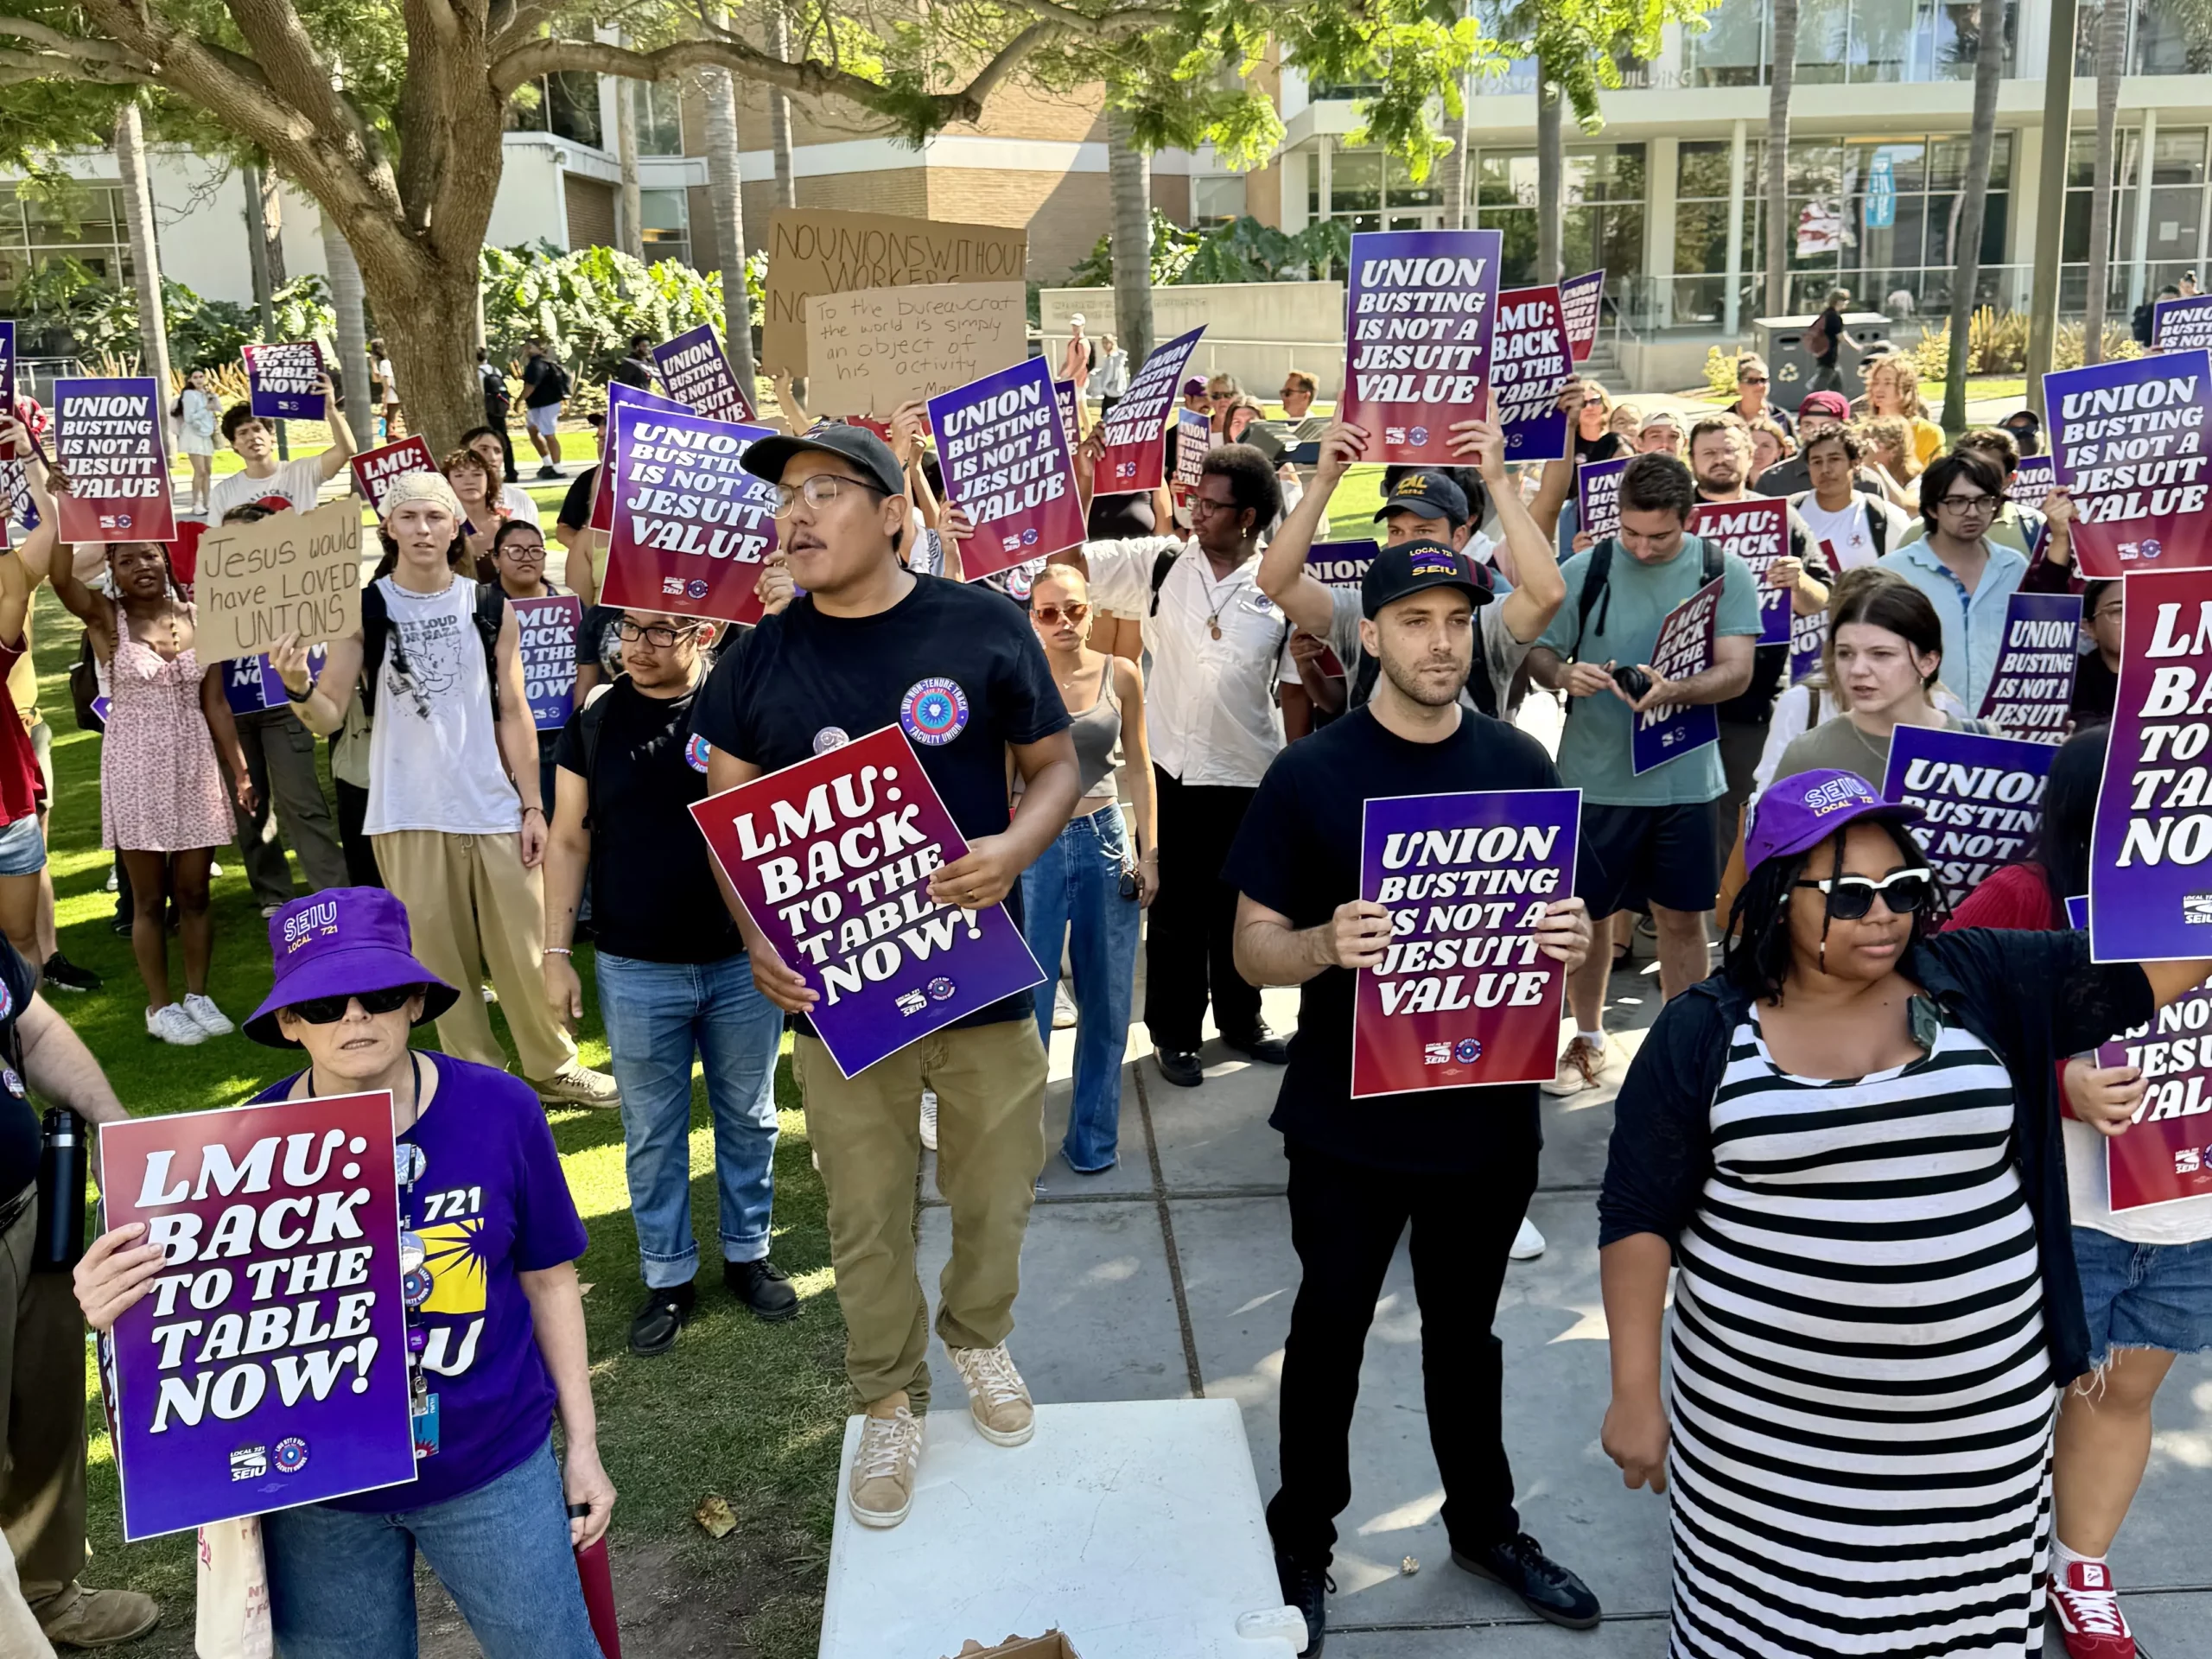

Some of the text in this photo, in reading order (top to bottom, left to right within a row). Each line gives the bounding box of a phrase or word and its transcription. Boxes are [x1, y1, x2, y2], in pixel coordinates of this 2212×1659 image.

[925, 236, 1027, 276] WITHOUT
[1361, 258, 1486, 288] UNION
[817, 296, 1017, 321] To the bureaucrat
[1357, 292, 1486, 313] BUSTING
[820, 318, 1001, 341] the world is simply
[1354, 319, 1479, 340] IS NOT A
[2160, 337, 2178, 348] IS
[252, 350, 315, 360] BACK
[662, 340, 714, 377] UNION
[827, 334, 977, 360] an object of
[1140, 340, 1195, 375] UNION
[1353, 346, 1483, 370] JESUIT
[255, 359, 316, 367] TO THE
[258, 367, 318, 378] TABLE
[669, 358, 722, 392] BUSTING
[836, 355, 976, 380] his activity
[1491, 356, 1564, 384] TO THE
[688, 379, 716, 401] NOT
[718, 372, 728, 388] A
[1130, 381, 1163, 402] NOT
[1158, 378, 1173, 395] A
[1356, 375, 1480, 404] VALUE
[2062, 375, 2197, 420] UNION
[63, 397, 149, 417] UNION
[944, 379, 1041, 437] UNION
[1107, 397, 1169, 423] JESUIT
[60, 421, 152, 435] BUSTING
[948, 406, 1051, 460] BUSTING
[1105, 418, 1162, 447] VALUE
[2062, 406, 2203, 444] BUSTING
[61, 439, 150, 454] IS NOT A
[952, 429, 1052, 481] IS NOT A
[2063, 431, 2200, 468] IS NOT A
[63, 458, 157, 475] JESUIT
[363, 447, 422, 480] LMU:
[957, 448, 1060, 502] JESUIT
[2067, 456, 2209, 495] JESUIT
[70, 478, 161, 499] VALUE
[628, 462, 767, 501] IS NOT A
[626, 486, 769, 530] JESUIT
[962, 472, 1065, 527] VALUE
[1587, 505, 1607, 520] IS
[2074, 484, 2209, 525] VALUE
[632, 515, 768, 563] VALUE
[1697, 511, 1780, 537] LMU:
[205, 516, 357, 578] Jesus would
[1409, 547, 1440, 556] LOCAL
[1412, 565, 1457, 576] SEIU
[210, 563, 358, 612] have LOVED
[235, 594, 344, 648] UNIONS
[422, 614, 457, 628] LOUD
[516, 606, 572, 627] MU:
[1661, 594, 1715, 645] LMU:
[521, 626, 575, 647] ACK
[1653, 616, 1710, 667] BACK
[2009, 620, 2075, 649] UNION
[1671, 640, 1707, 671] THE
[2000, 652, 2073, 674] BUSTING
[902, 678, 968, 714] LMU NON-TENURE TRACK
[1992, 677, 2069, 701] IS NOT A
[1987, 703, 2070, 728] JESUIT
[909, 722, 963, 743] FACULTY UNION
[2139, 722, 2210, 763] TO
[1805, 778, 1867, 809] SEIU
[1815, 800, 1853, 817] LOCAL
[732, 766, 901, 861] LMU:
[757, 804, 927, 906] BACK
[1382, 825, 1560, 870] UNION
[1936, 832, 2024, 860] NOT
[779, 842, 945, 938] TO THE
[1377, 868, 1560, 904] BUSTING
[283, 901, 338, 942] SEIU
[1422, 902, 1516, 934] NOT
[1515, 900, 1548, 928] A
[288, 925, 338, 954] LOCAL 721
[819, 909, 982, 1007] NOW!
[1372, 935, 1540, 976] JESUIT
[903, 1000, 927, 1017] SEIU
[1378, 971, 1550, 1017] VALUE
[1424, 1056, 1450, 1065] SEIU
[135, 1128, 368, 1208] LMU:
[424, 1186, 481, 1223] 721
[149, 1186, 371, 1268] BACK
[148, 1245, 373, 1318] TO THE
[150, 1292, 376, 1370] TABLE
[149, 1336, 379, 1434] NOW!
[232, 1465, 267, 1482] SEIU
